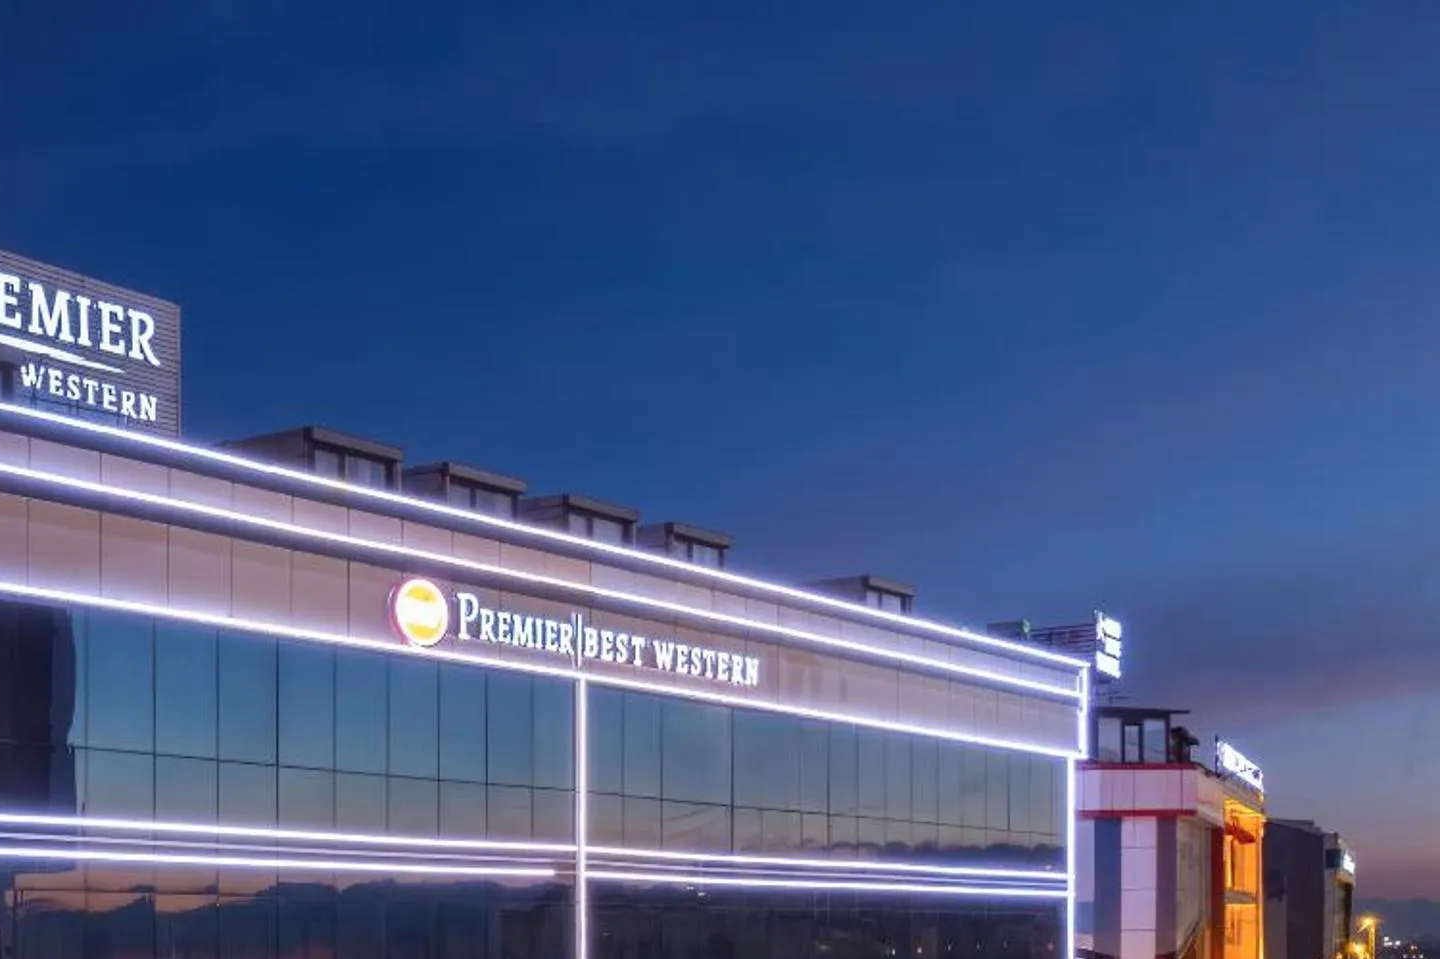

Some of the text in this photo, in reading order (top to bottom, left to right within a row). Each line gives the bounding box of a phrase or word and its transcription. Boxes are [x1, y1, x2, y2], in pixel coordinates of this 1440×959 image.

[20, 362, 158, 421] WESTERN
[456, 592, 760, 687] PREMIER BEST WESTERN
